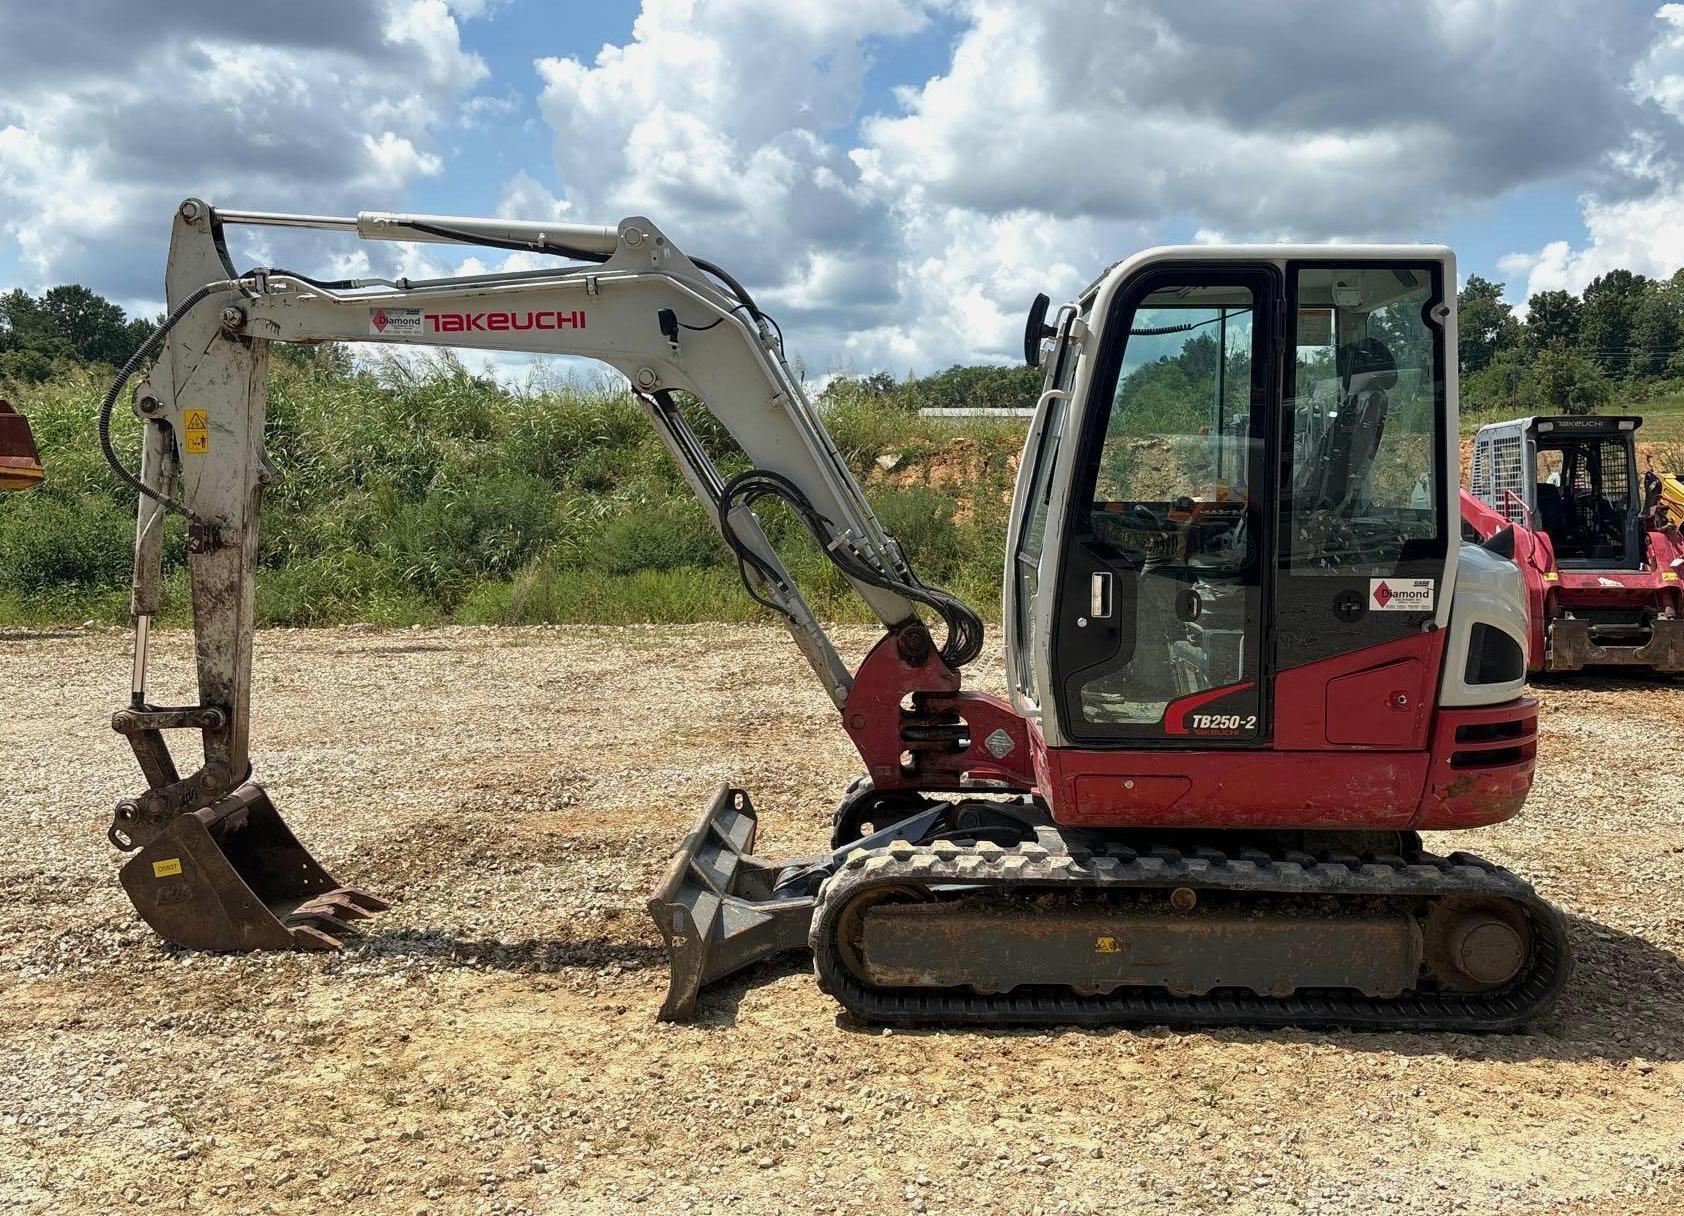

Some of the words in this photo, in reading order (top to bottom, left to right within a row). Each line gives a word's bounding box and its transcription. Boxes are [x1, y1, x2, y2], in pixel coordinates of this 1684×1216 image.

[379, 316, 421, 325] Diamond
[1381, 588, 1430, 598] Diamond
[1192, 715, 1257, 729] TB250-2
